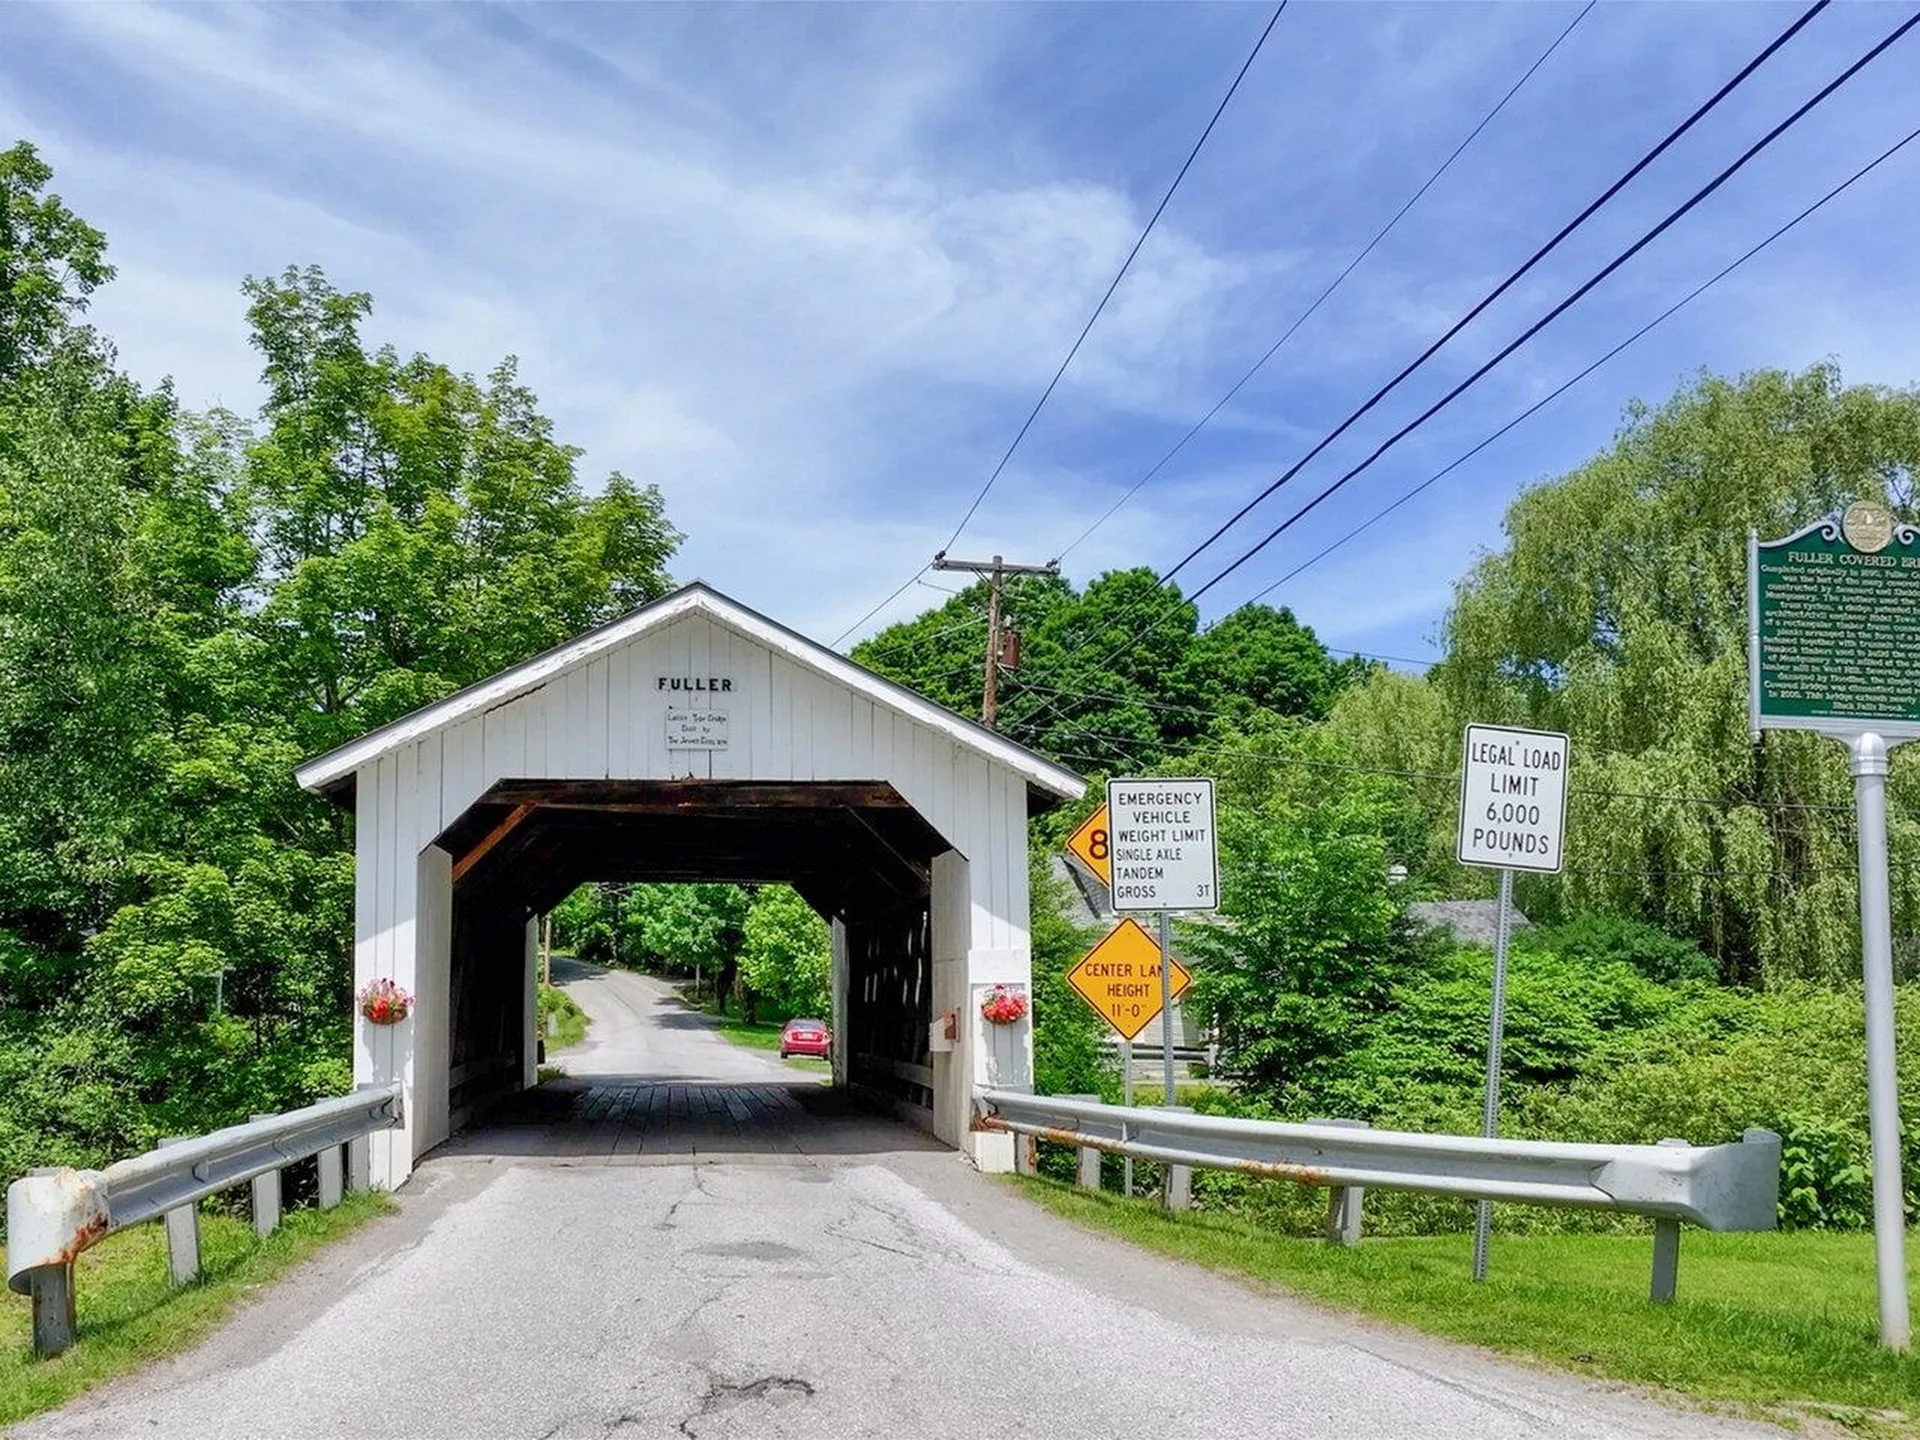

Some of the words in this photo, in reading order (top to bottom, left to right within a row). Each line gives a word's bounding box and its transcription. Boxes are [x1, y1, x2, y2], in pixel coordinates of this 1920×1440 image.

[1788, 551, 1833, 564] FULLER
[1839, 554, 1896, 567] COVERED
[658, 677, 732, 692] FULLER
[1472, 742, 1515, 766] LEGAL
[1524, 748, 1561, 771] LOAD
[1491, 773, 1539, 797] LIMIT
[1118, 792, 1202, 806] EMERGENCY
[1132, 810, 1191, 824] VEHICLE
[1486, 802, 1540, 825] 6,000
[1118, 829, 1166, 843] WEIGHT
[1172, 828, 1206, 842] LIMIT
[1473, 828, 1549, 855] POUNDS
[1115, 848, 1152, 861] SINGLE
[1156, 848, 1182, 861] AXLE
[1116, 867, 1164, 879] TANDEM
[1116, 886, 1156, 899] GROSS
[1196, 884, 1210, 897] 3T
[1085, 963, 1132, 977] CENTER
[1107, 983, 1150, 998] HEIGHT
